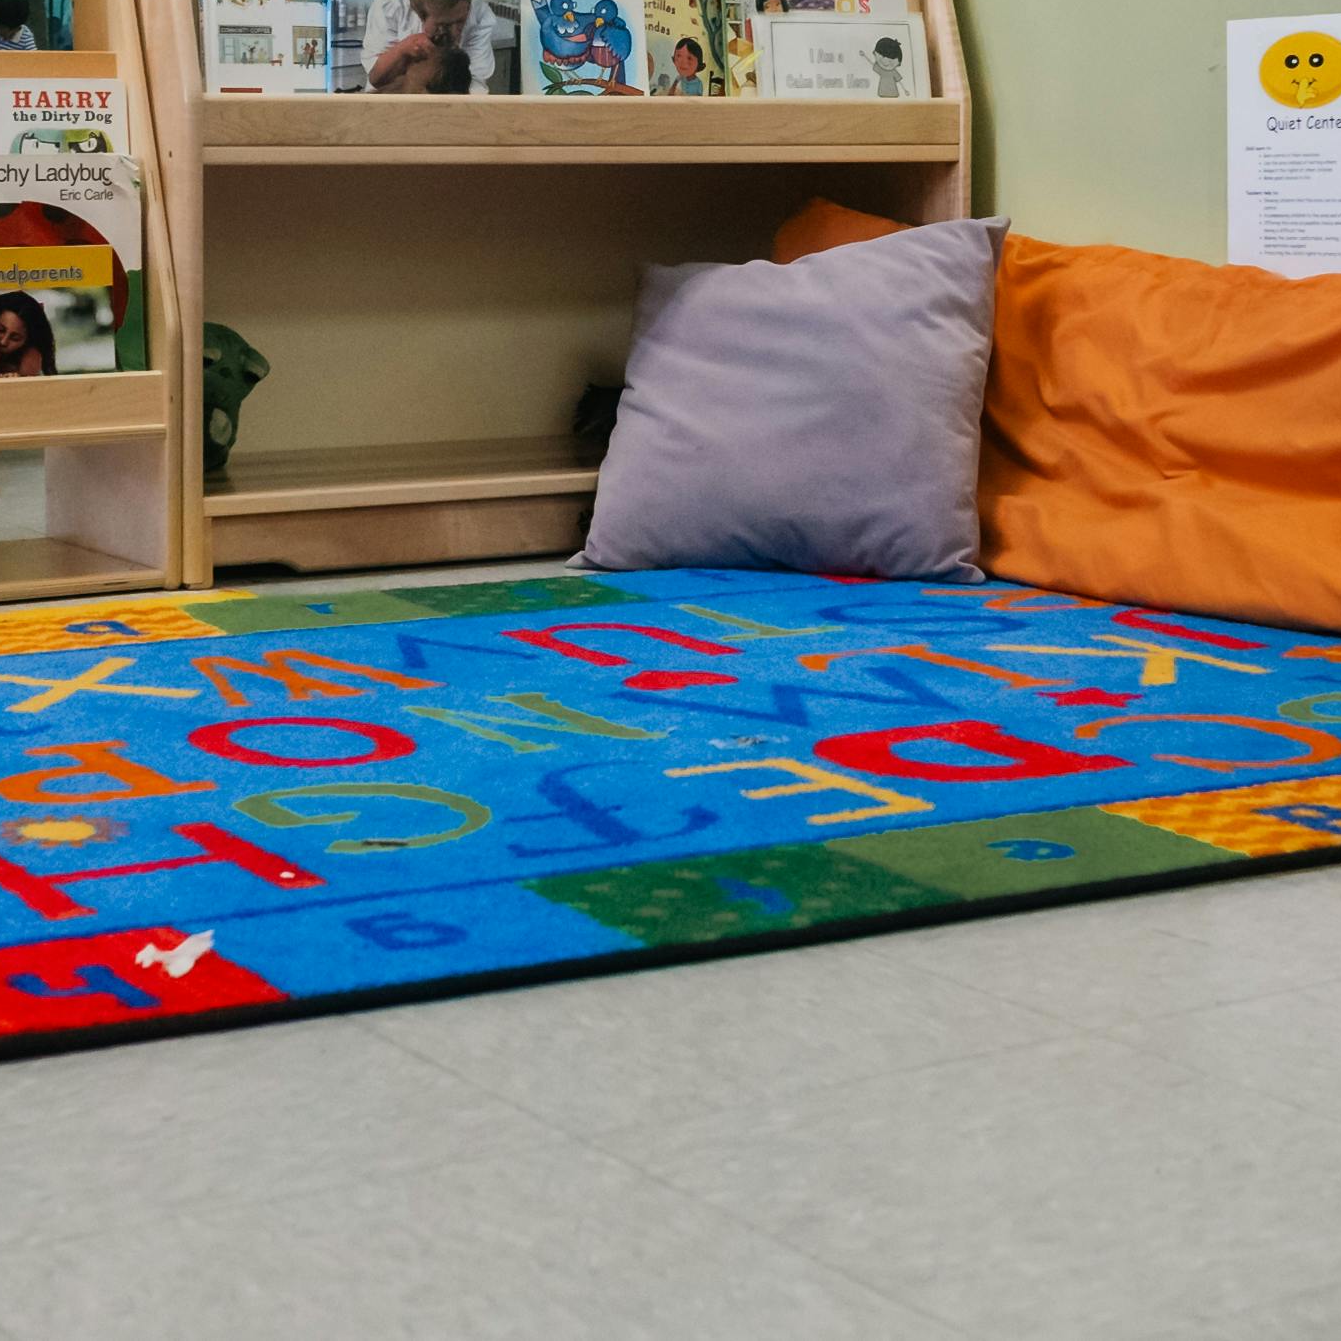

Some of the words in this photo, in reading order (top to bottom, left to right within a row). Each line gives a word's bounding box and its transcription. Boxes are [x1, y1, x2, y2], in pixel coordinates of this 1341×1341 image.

[12, 91, 111, 108] HARRY
[13, 111, 37, 121] the
[42, 111, 80, 123] Dirty
[85, 111, 113, 124] Dog
[1266, 115, 1301, 134] Quiet
[60, 189, 82, 201] Eric
[85, 189, 113, 201] Carle
